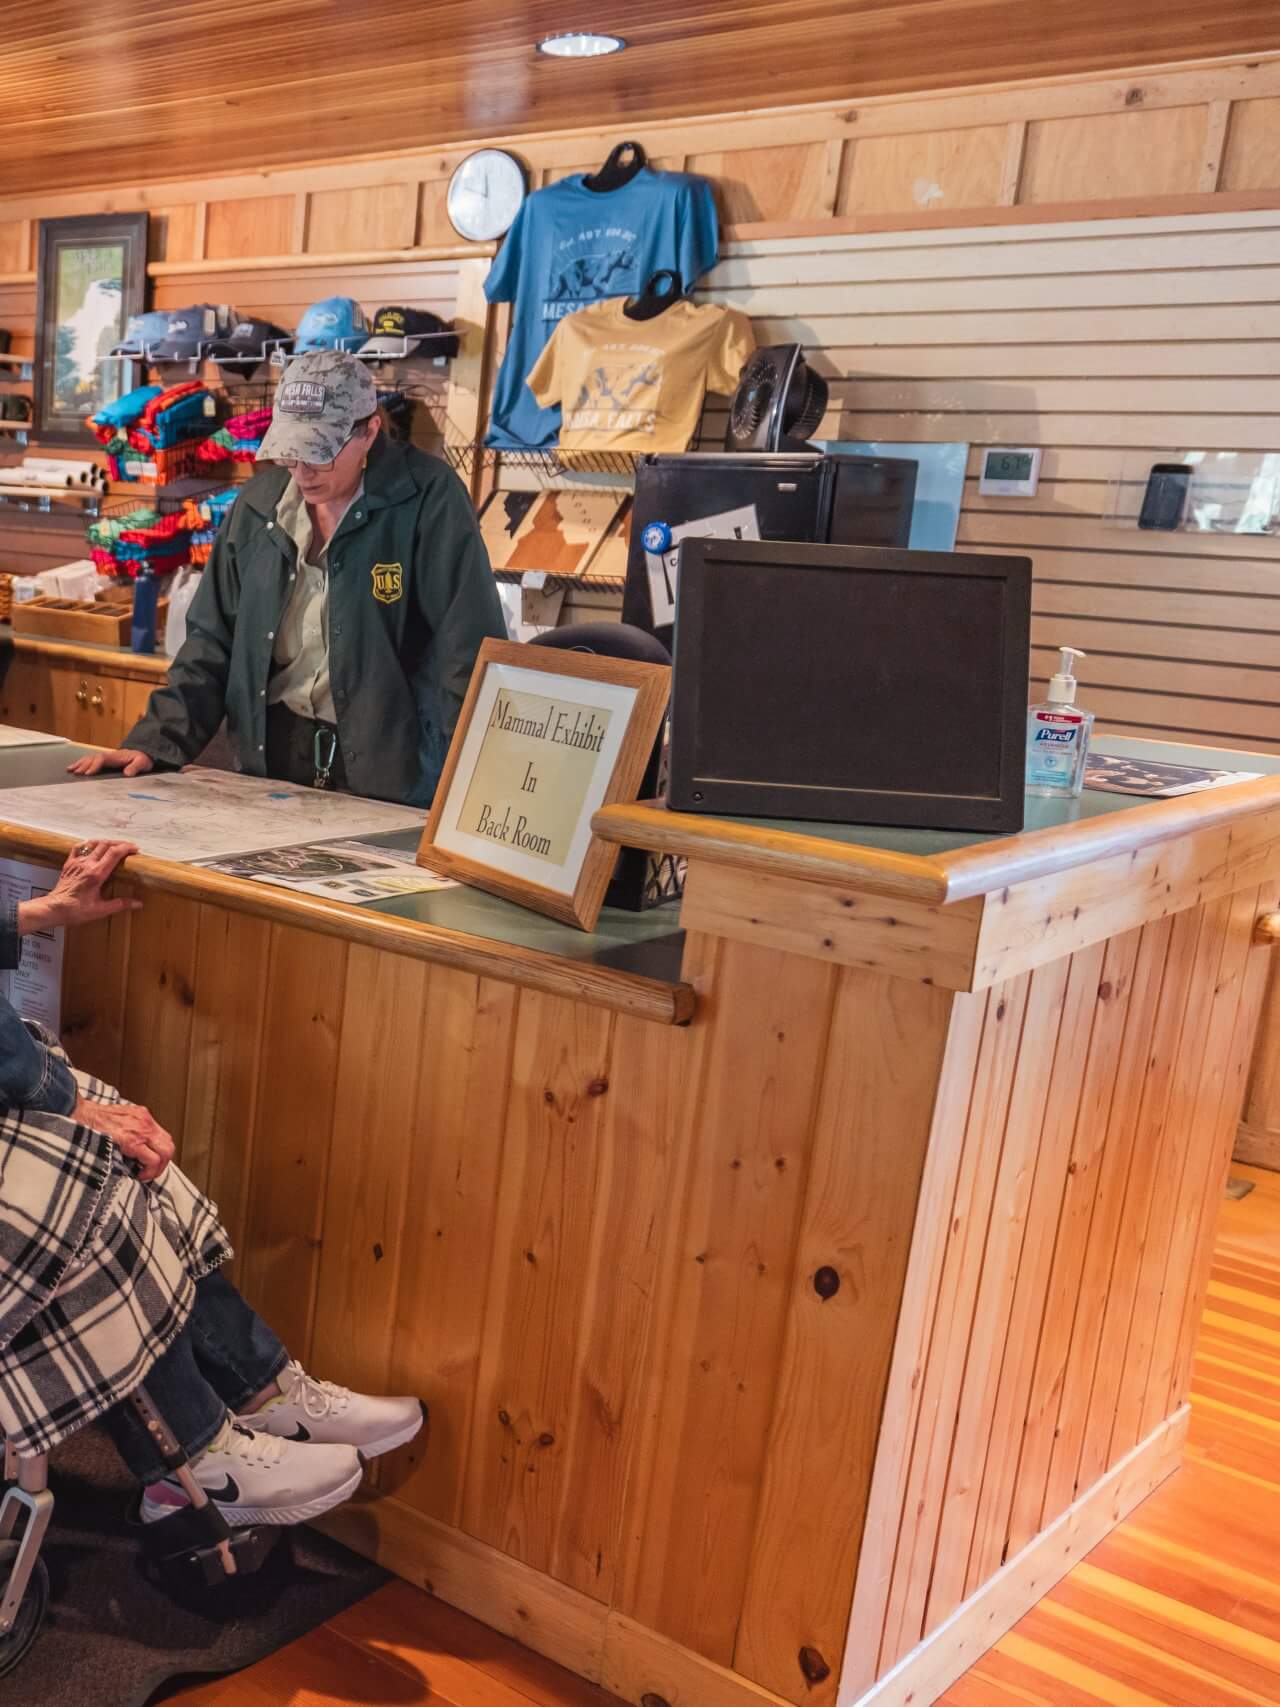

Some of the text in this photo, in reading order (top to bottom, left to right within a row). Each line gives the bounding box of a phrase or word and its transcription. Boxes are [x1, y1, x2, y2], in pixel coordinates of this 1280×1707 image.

[301, 384, 324, 397] FALLS
[490, 700, 606, 753] Mammal Exhibit
[1040, 728, 1073, 741] Purell
[520, 761, 538, 794] In
[475, 804, 552, 856] Back Room
